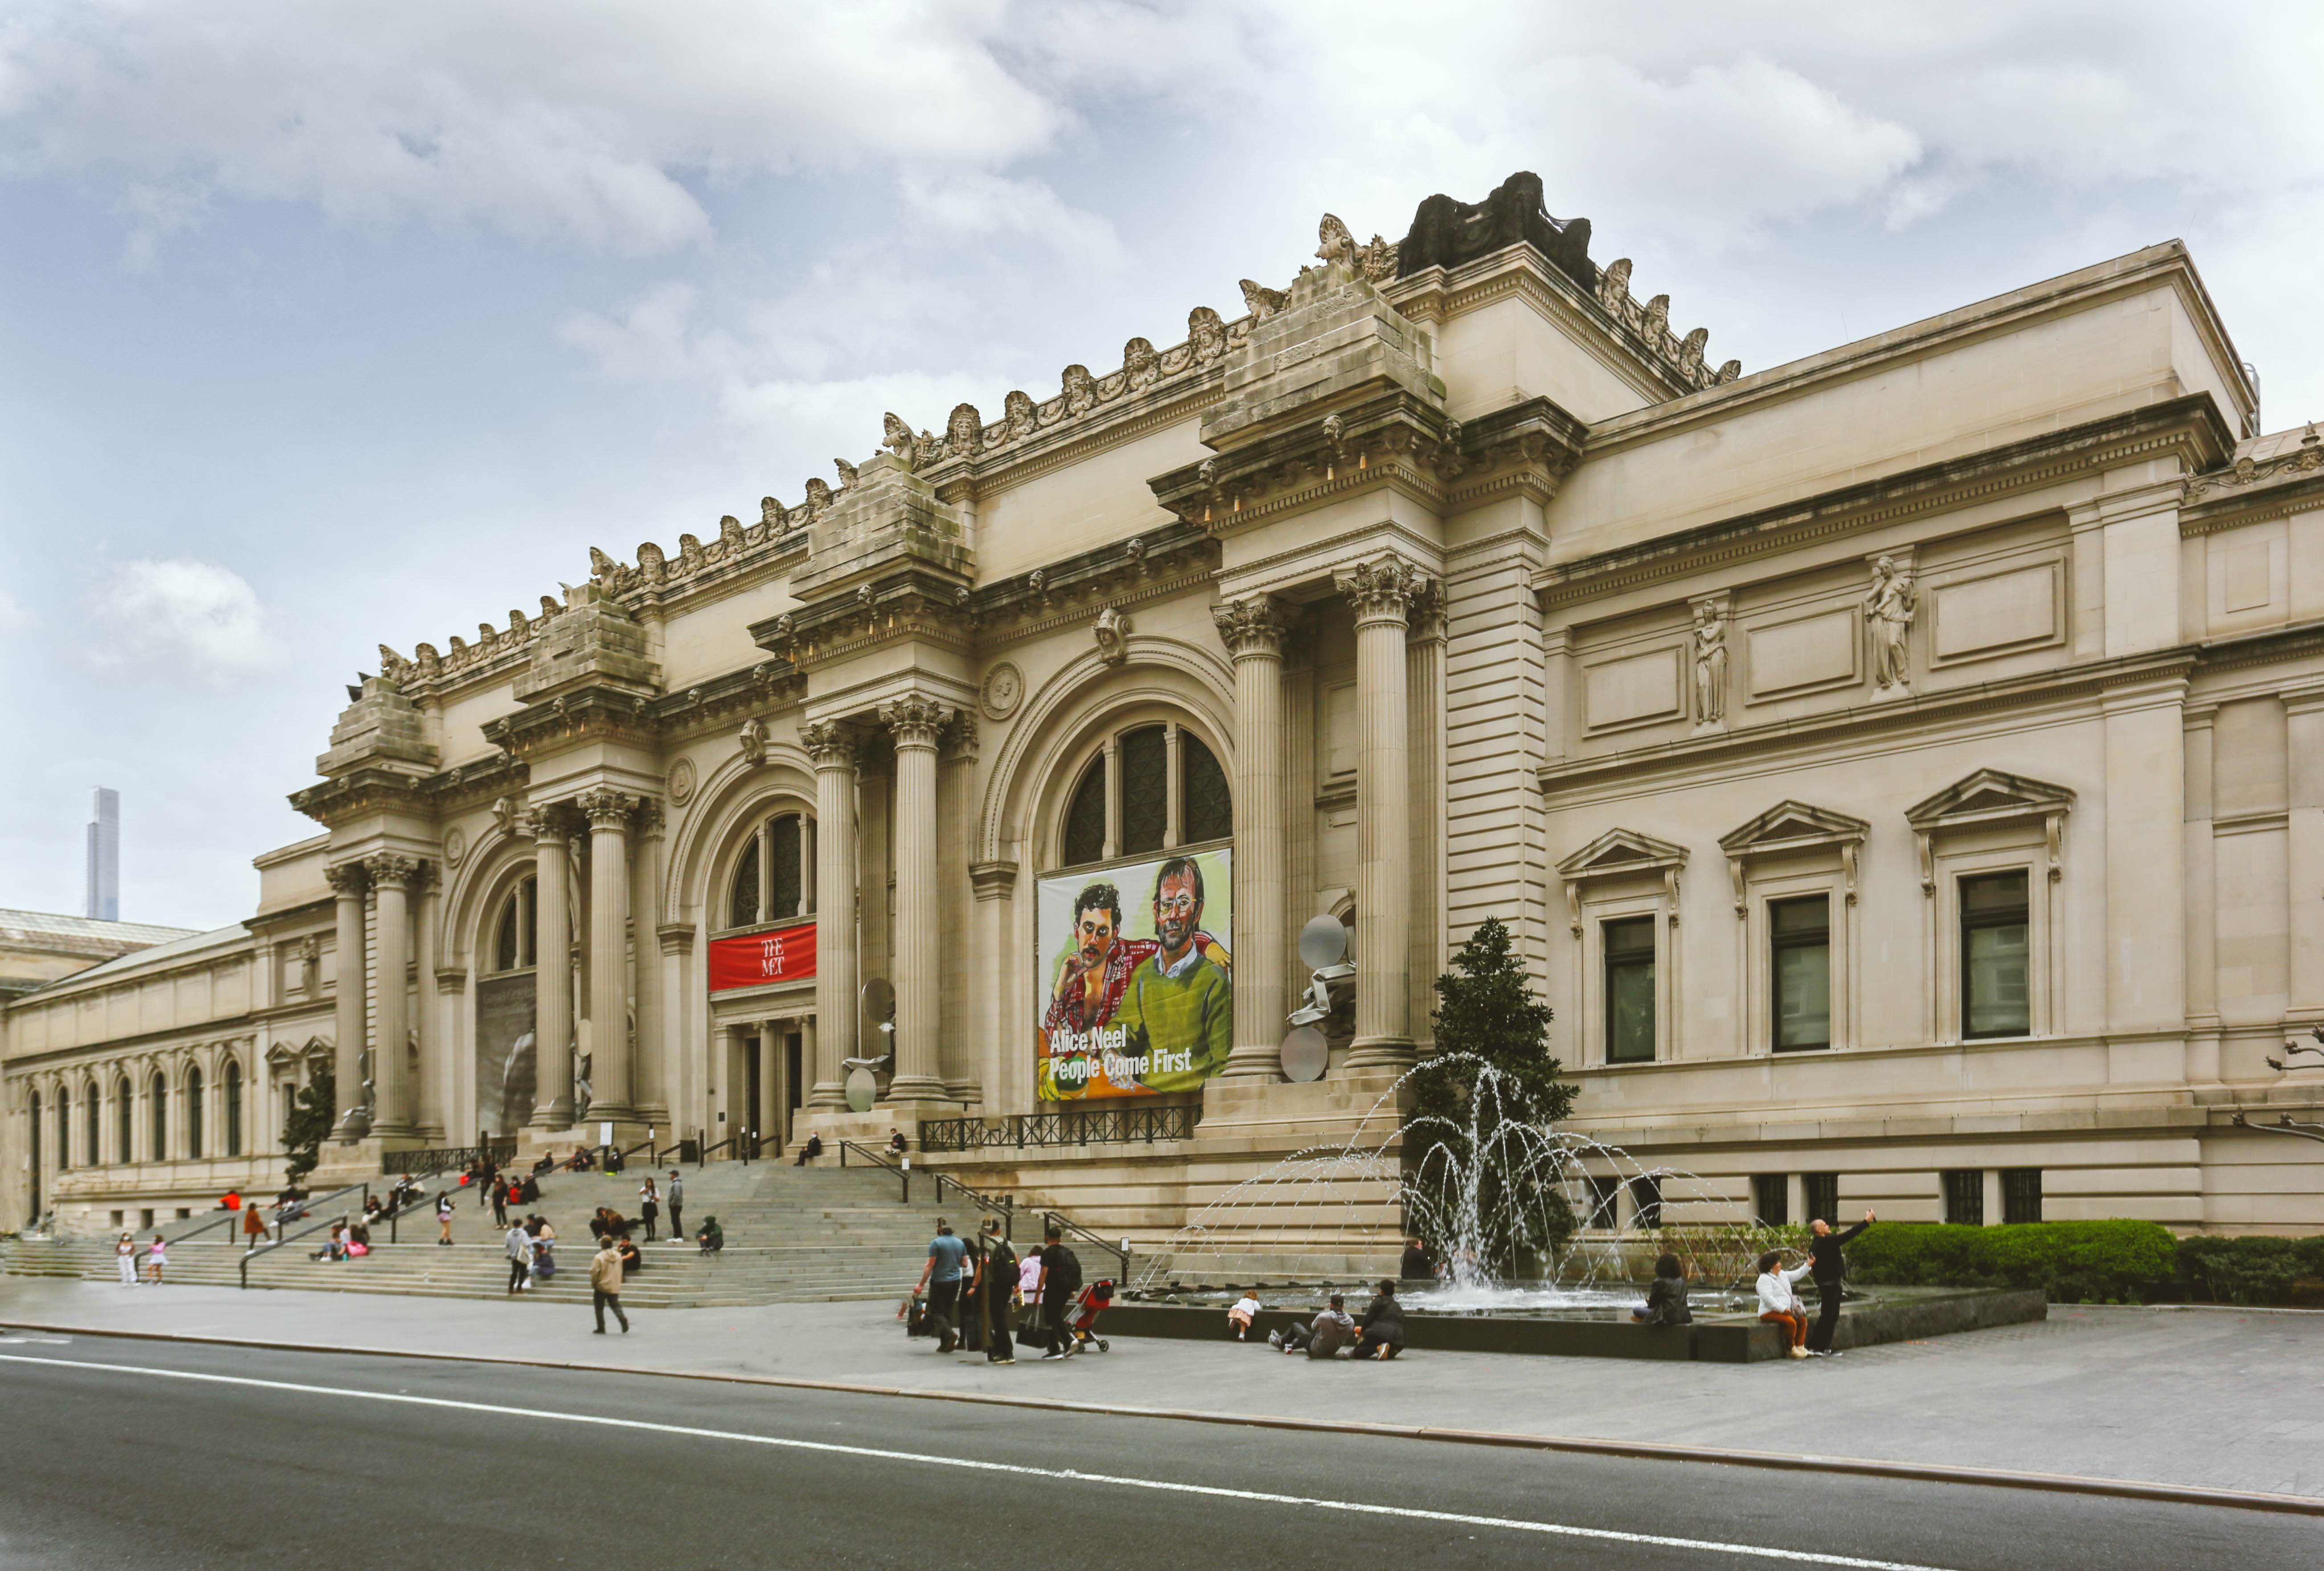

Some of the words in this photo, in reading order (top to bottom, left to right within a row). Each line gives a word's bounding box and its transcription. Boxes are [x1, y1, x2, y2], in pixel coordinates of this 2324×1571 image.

[761, 938, 784, 957] THE
[761, 956, 784, 976] MET
[1050, 1029, 1088, 1053] Alice
[1092, 1024, 1126, 1049] Neel
[1050, 1055, 1100, 1084] People
[1103, 1053, 1149, 1077] Come
[1153, 1047, 1192, 1073] First
